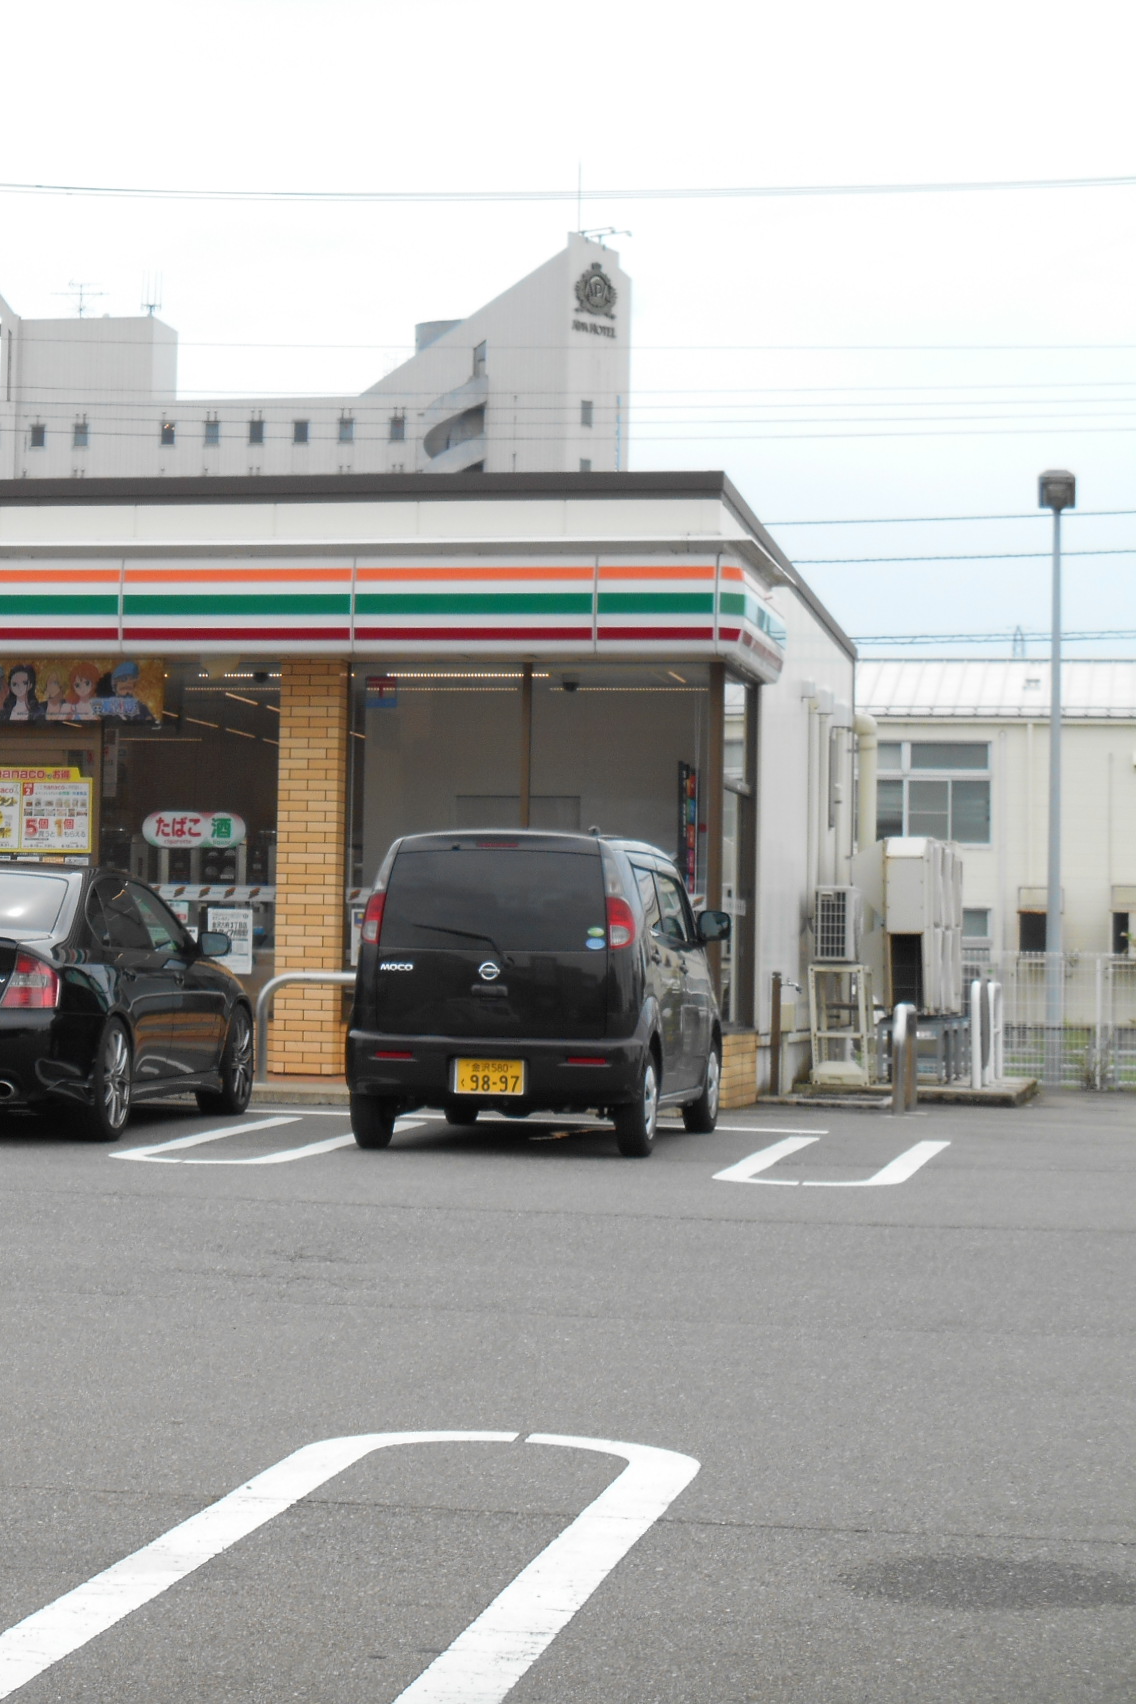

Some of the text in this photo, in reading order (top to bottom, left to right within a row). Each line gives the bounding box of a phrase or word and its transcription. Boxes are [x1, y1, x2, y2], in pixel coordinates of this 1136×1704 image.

[589, 323, 616, 338] HOTEL
[155, 816, 202, 838] たばこ
[211, 817, 232, 839] 酒
[380, 963, 414, 971] MOCO
[470, 1074, 520, 1093] 98-97
